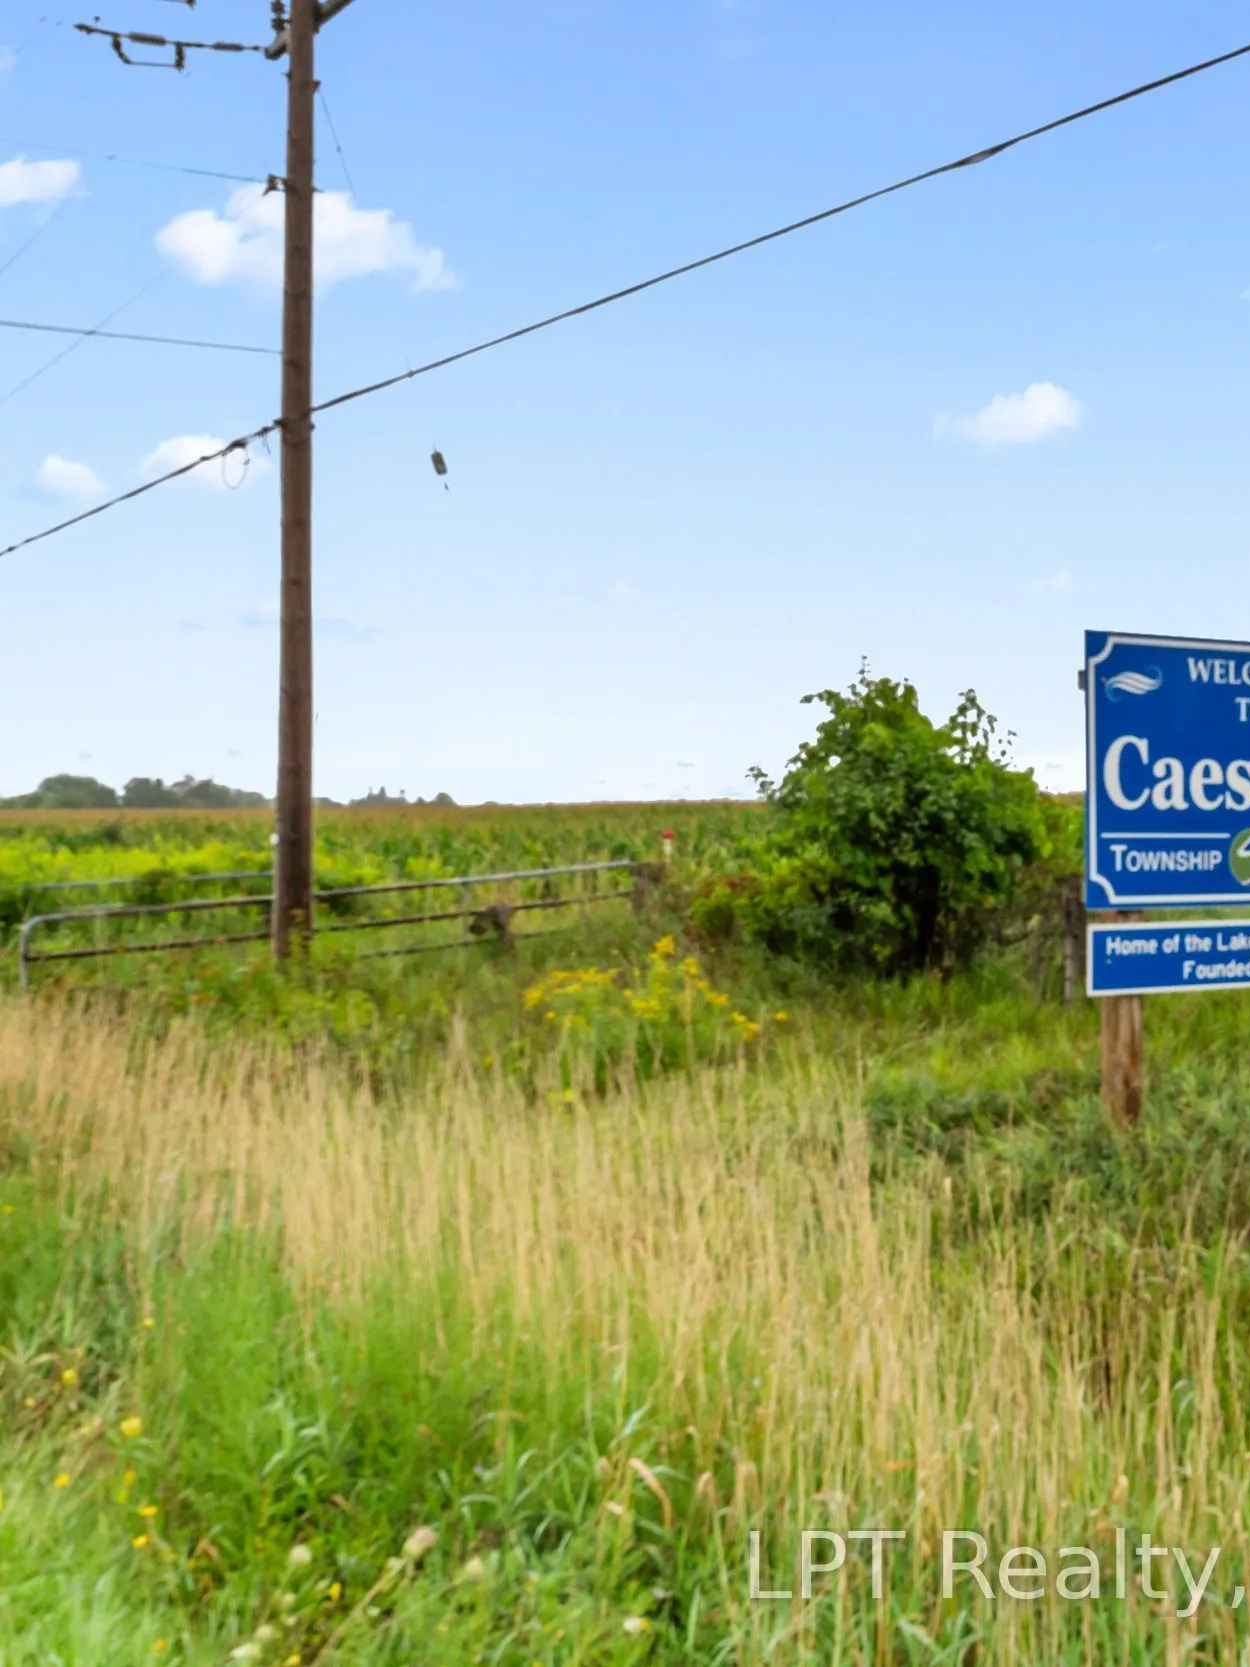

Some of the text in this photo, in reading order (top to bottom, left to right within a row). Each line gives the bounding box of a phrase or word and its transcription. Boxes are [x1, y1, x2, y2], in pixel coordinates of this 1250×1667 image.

[1109, 844, 1222, 872] TOWNSHIP
[1106, 936, 1158, 957] Home
[1162, 935, 1181, 953] of
[1184, 933, 1212, 952] the
